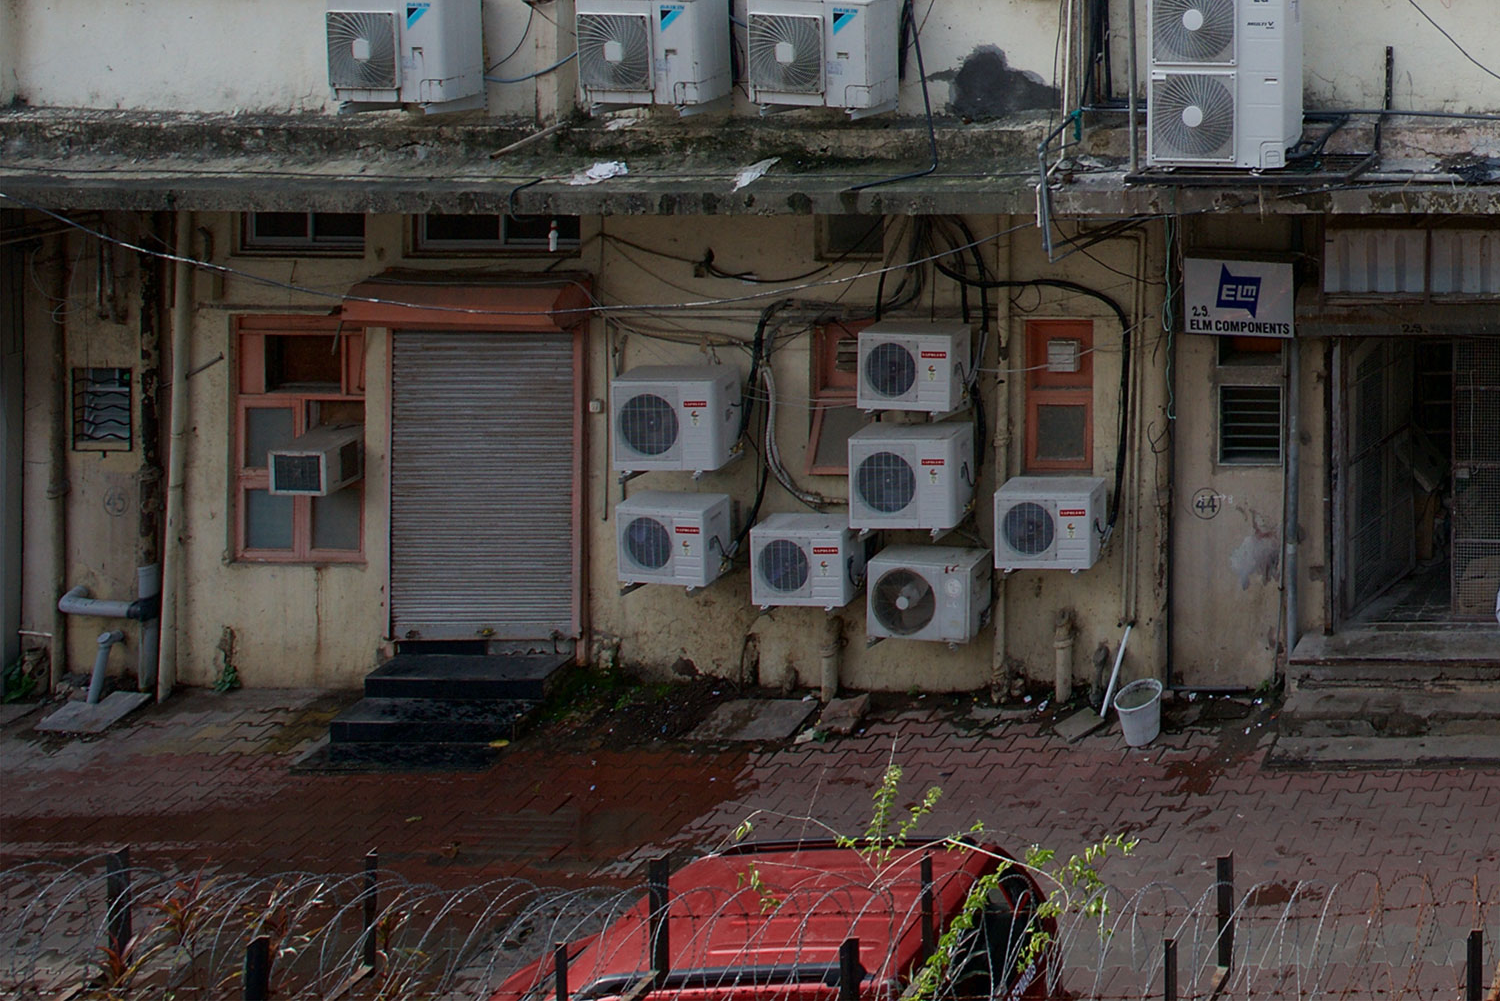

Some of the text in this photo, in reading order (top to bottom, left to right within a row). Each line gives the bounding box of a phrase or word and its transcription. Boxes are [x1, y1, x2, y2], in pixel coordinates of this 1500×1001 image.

[1190, 319, 1290, 334] ELM COMPONENTS
[106, 494, 125, 512] 45
[1196, 495, 1216, 512] 44
